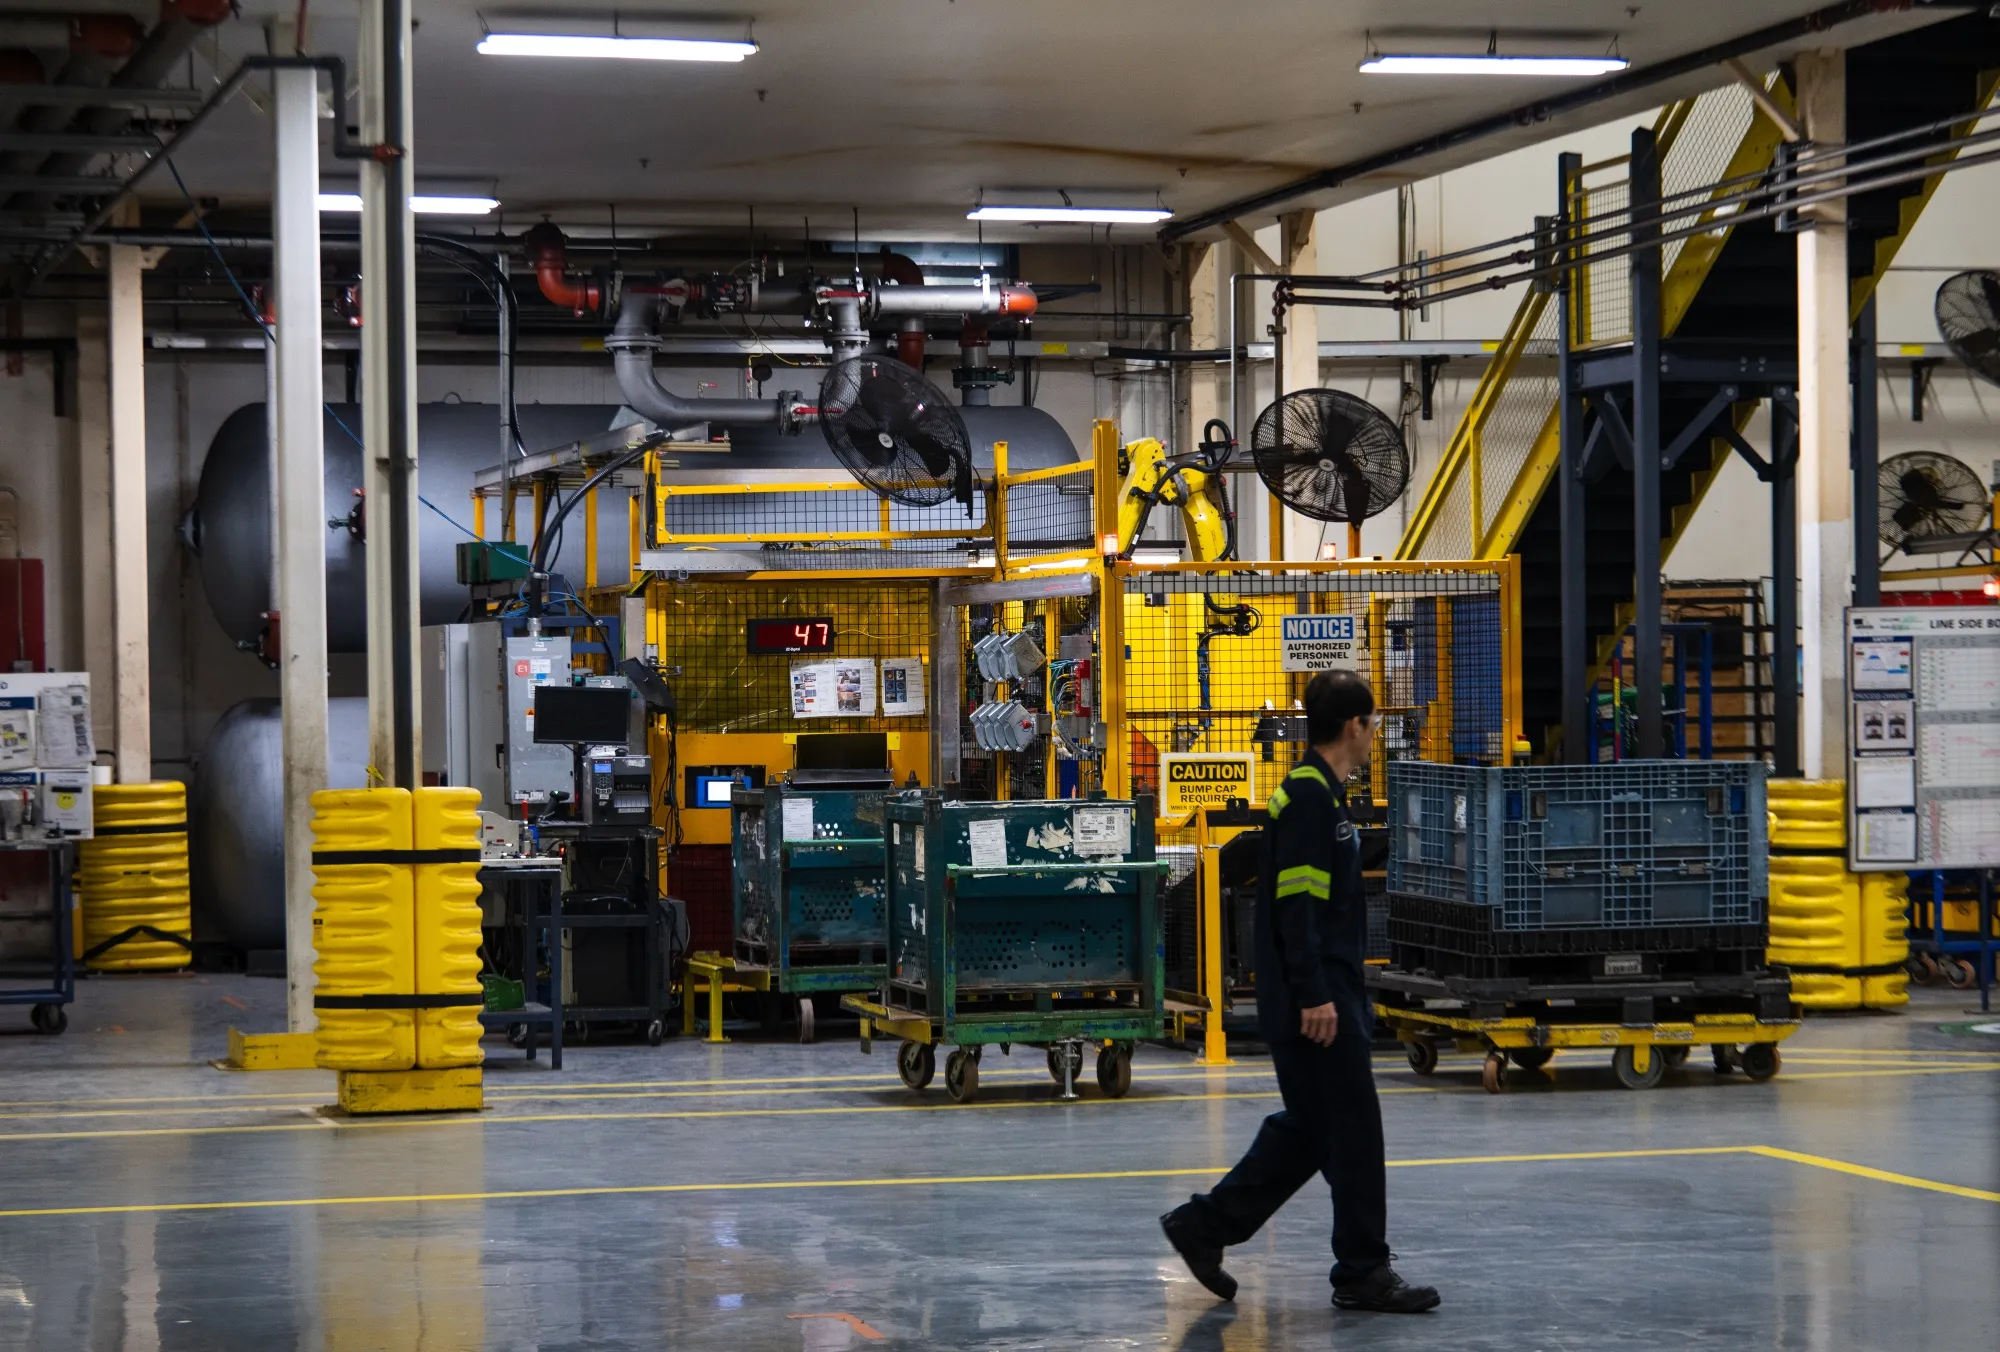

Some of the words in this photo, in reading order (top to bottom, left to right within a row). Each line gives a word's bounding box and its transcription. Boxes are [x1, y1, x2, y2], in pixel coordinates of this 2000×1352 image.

[1930, 619, 1954, 629] LINE
[1958, 619, 1982, 629] SIDE
[1286, 619, 1351, 639] NOTICE
[795, 623, 828, 646] 47
[1287, 643, 1351, 651] AUTHORIZED
[1289, 652, 1349, 660] PERSONNEL
[517, 665, 528, 673] E1
[1306, 661, 1333, 669] ONLY
[1172, 764, 1245, 780] CAUTION
[1180, 785, 1212, 793] BUMP
[1215, 785, 1237, 793] CAP
